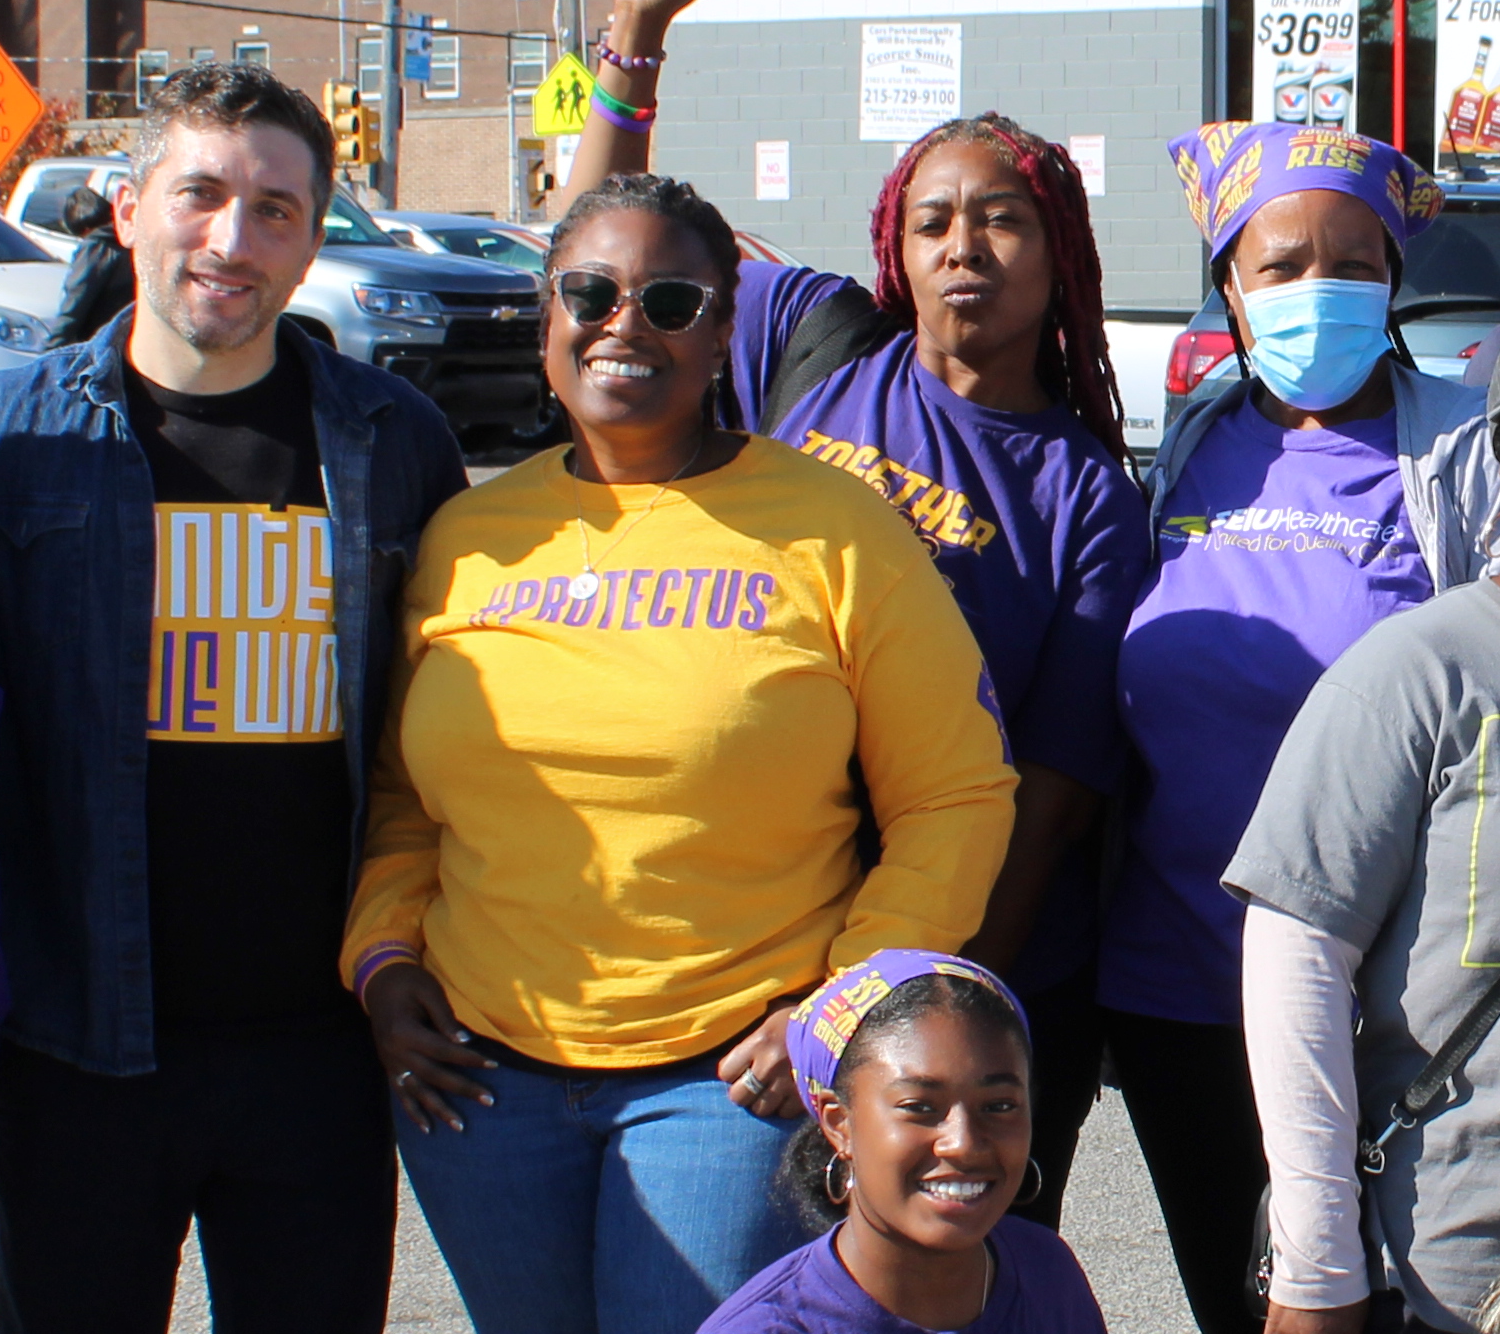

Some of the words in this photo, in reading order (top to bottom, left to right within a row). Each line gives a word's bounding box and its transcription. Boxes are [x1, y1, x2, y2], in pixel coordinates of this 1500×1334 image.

[888, 27, 918, 35] Parked
[866, 49, 911, 65] George
[915, 47, 954, 67] Smith
[900, 64, 921, 74] Inc.
[864, 88, 956, 105] 215-729-9100
[766, 162, 780, 174] NO
[1285, 147, 1367, 176] RISE
[1204, 530, 1261, 553] United
[1263, 534, 1291, 552] for
[1294, 532, 1357, 557] Quality
[468, 568, 776, 632] #PROTECTUS
